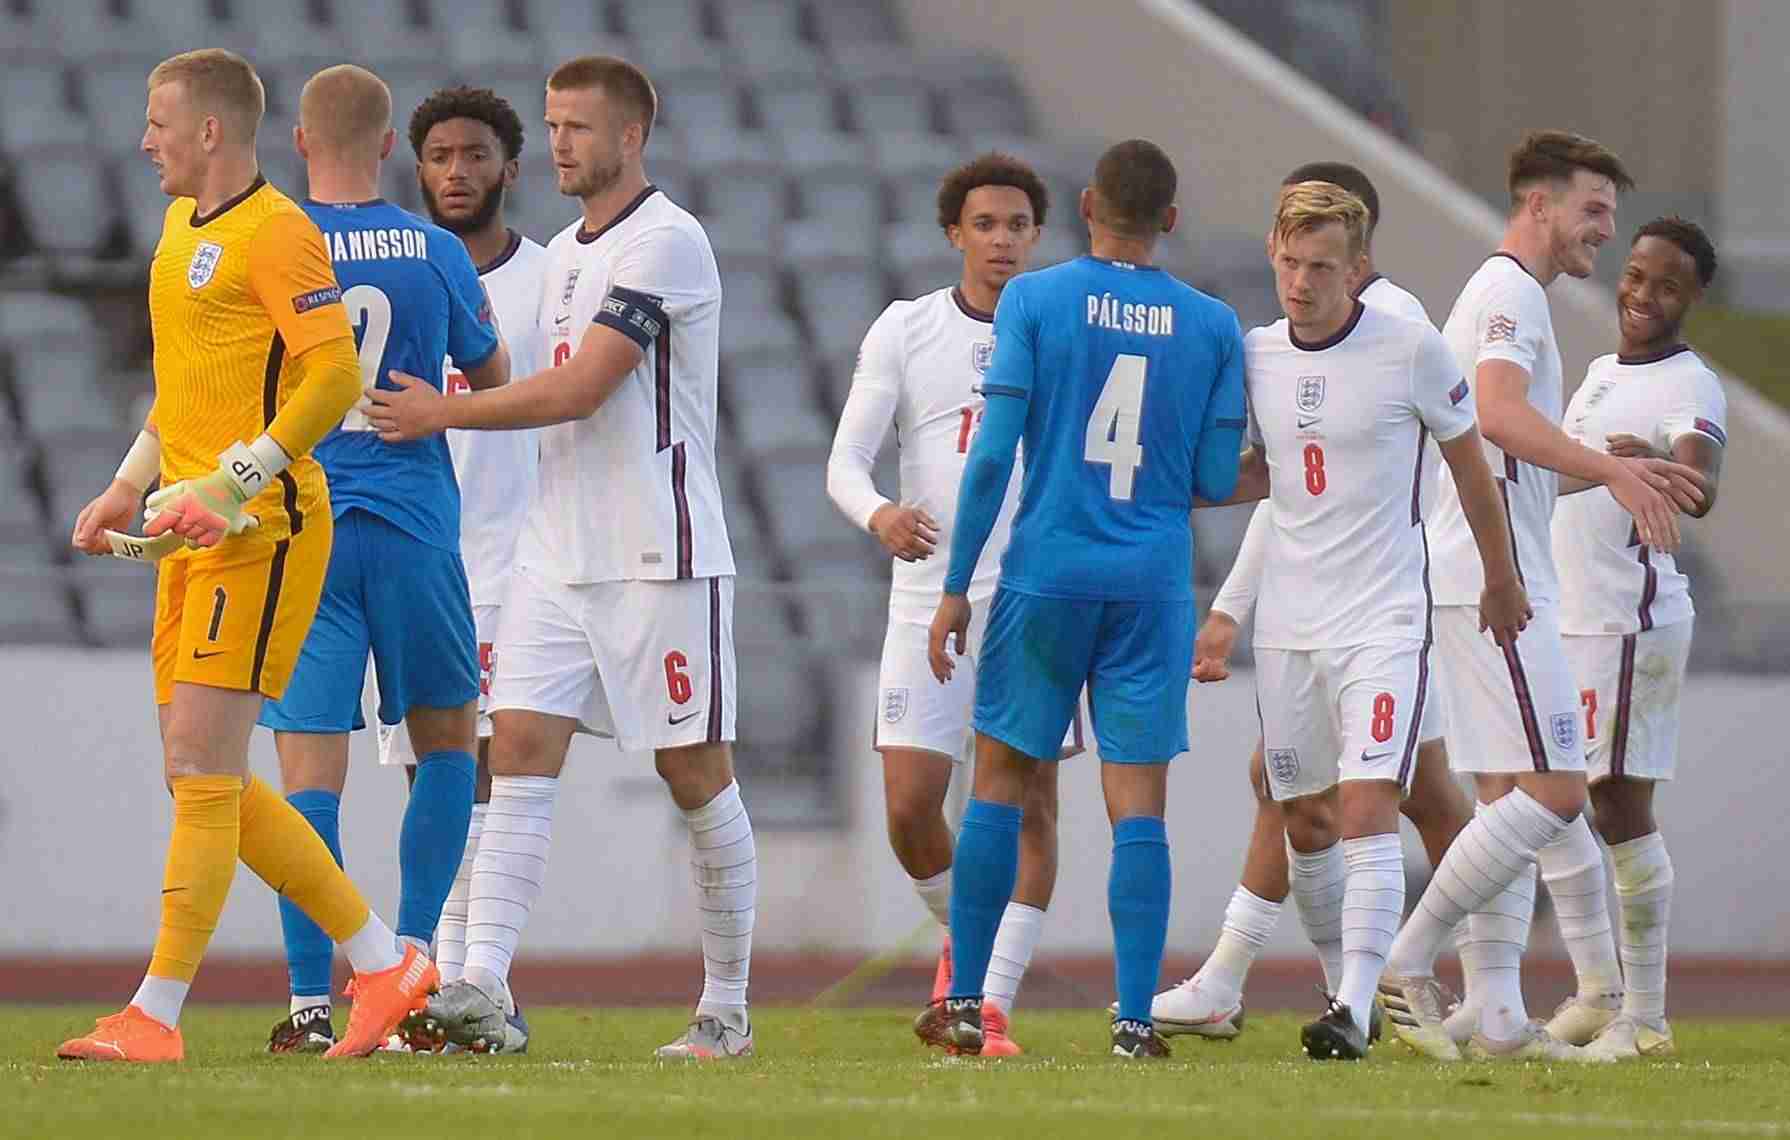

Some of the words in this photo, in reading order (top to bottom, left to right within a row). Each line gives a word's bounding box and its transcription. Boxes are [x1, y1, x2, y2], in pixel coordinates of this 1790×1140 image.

[1087, 292, 1173, 335] PÁLSSON
[341, 285, 391, 430] 2
[1084, 354, 1147, 500] 4
[232, 460, 262, 483] JP
[1303, 442, 1327, 497] 8
[122, 543, 143, 559] JP
[207, 585, 226, 642] 1
[664, 649, 692, 705] 6
[1371, 691, 1396, 743] 8
[1580, 688, 1598, 740] 7
[400, 951, 429, 992] PUMA
